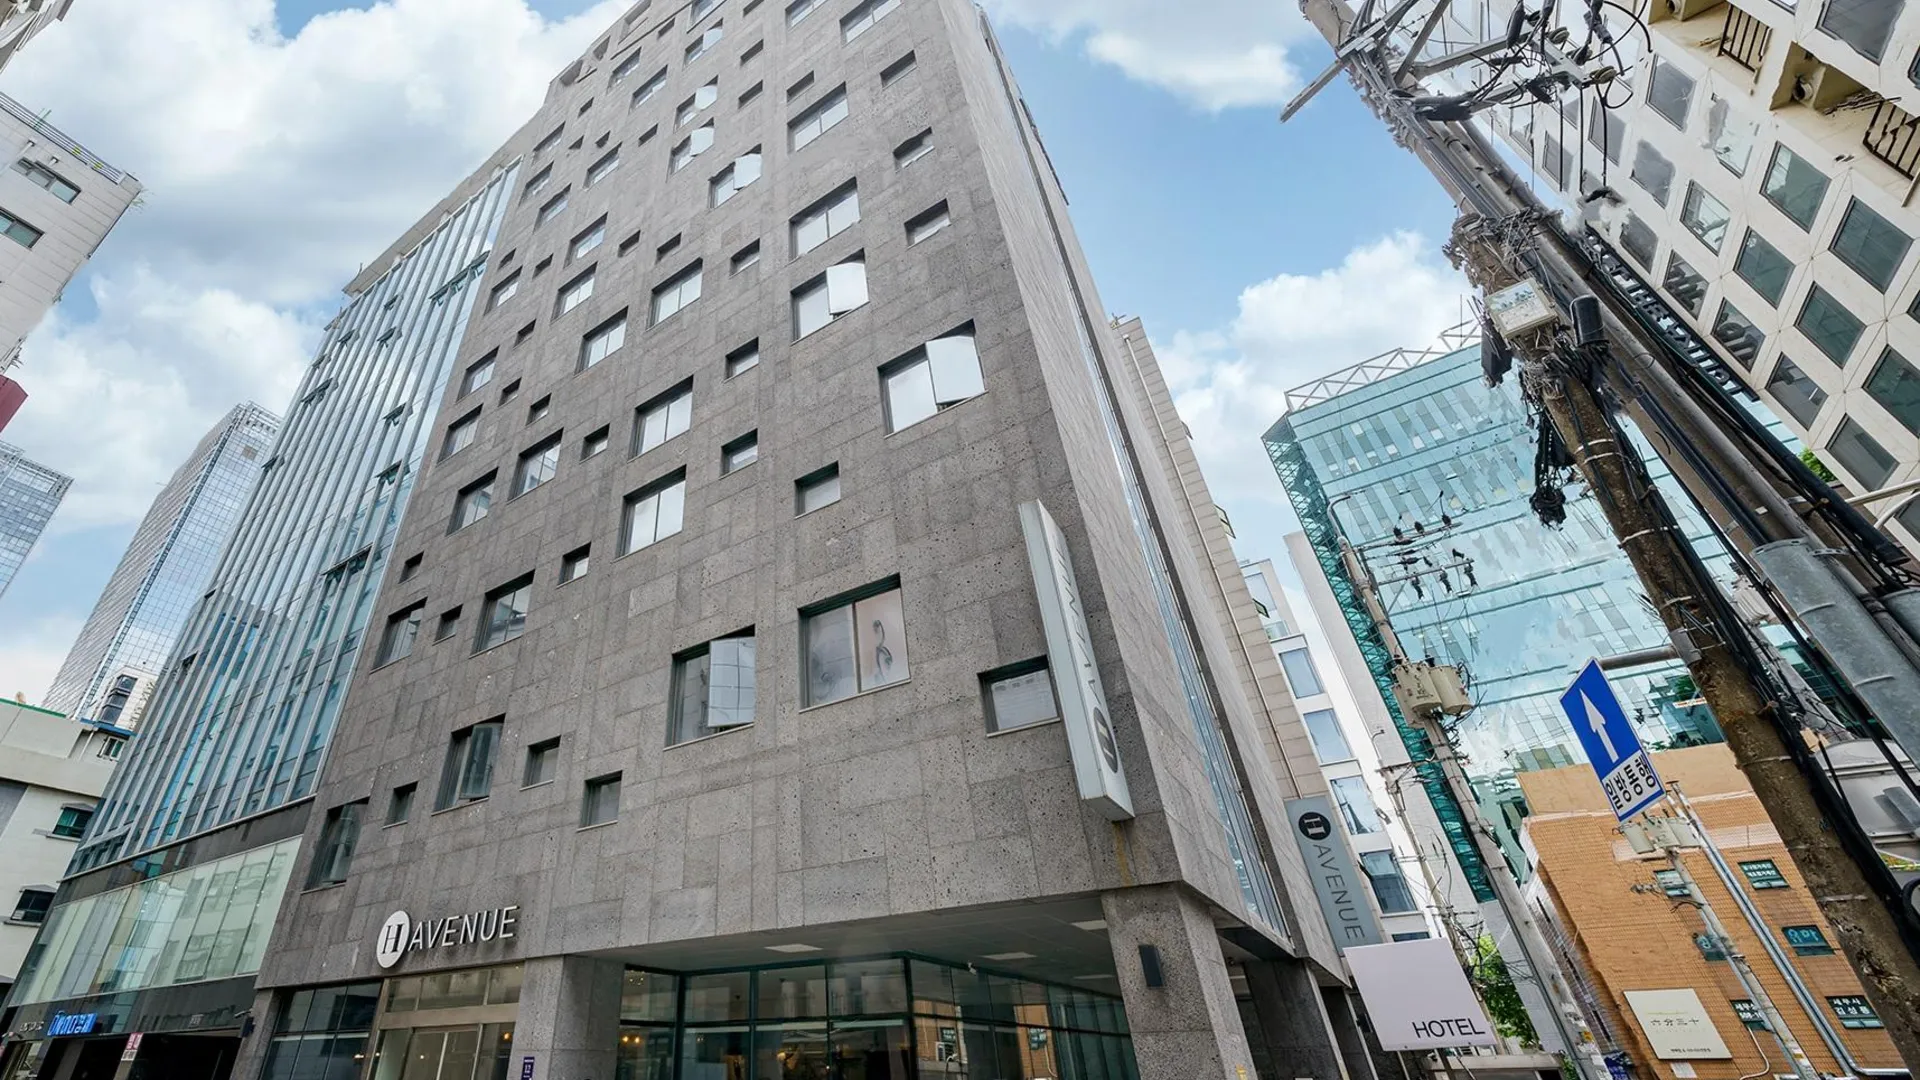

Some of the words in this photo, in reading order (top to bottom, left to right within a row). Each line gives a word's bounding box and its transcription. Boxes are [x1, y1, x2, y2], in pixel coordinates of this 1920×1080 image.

[1605, 754, 1656, 810] 일방통행
[1313, 844, 1365, 939] AVENUE
[407, 905, 519, 951] AVENUE
[1412, 1018, 1485, 1038] HOTEL
